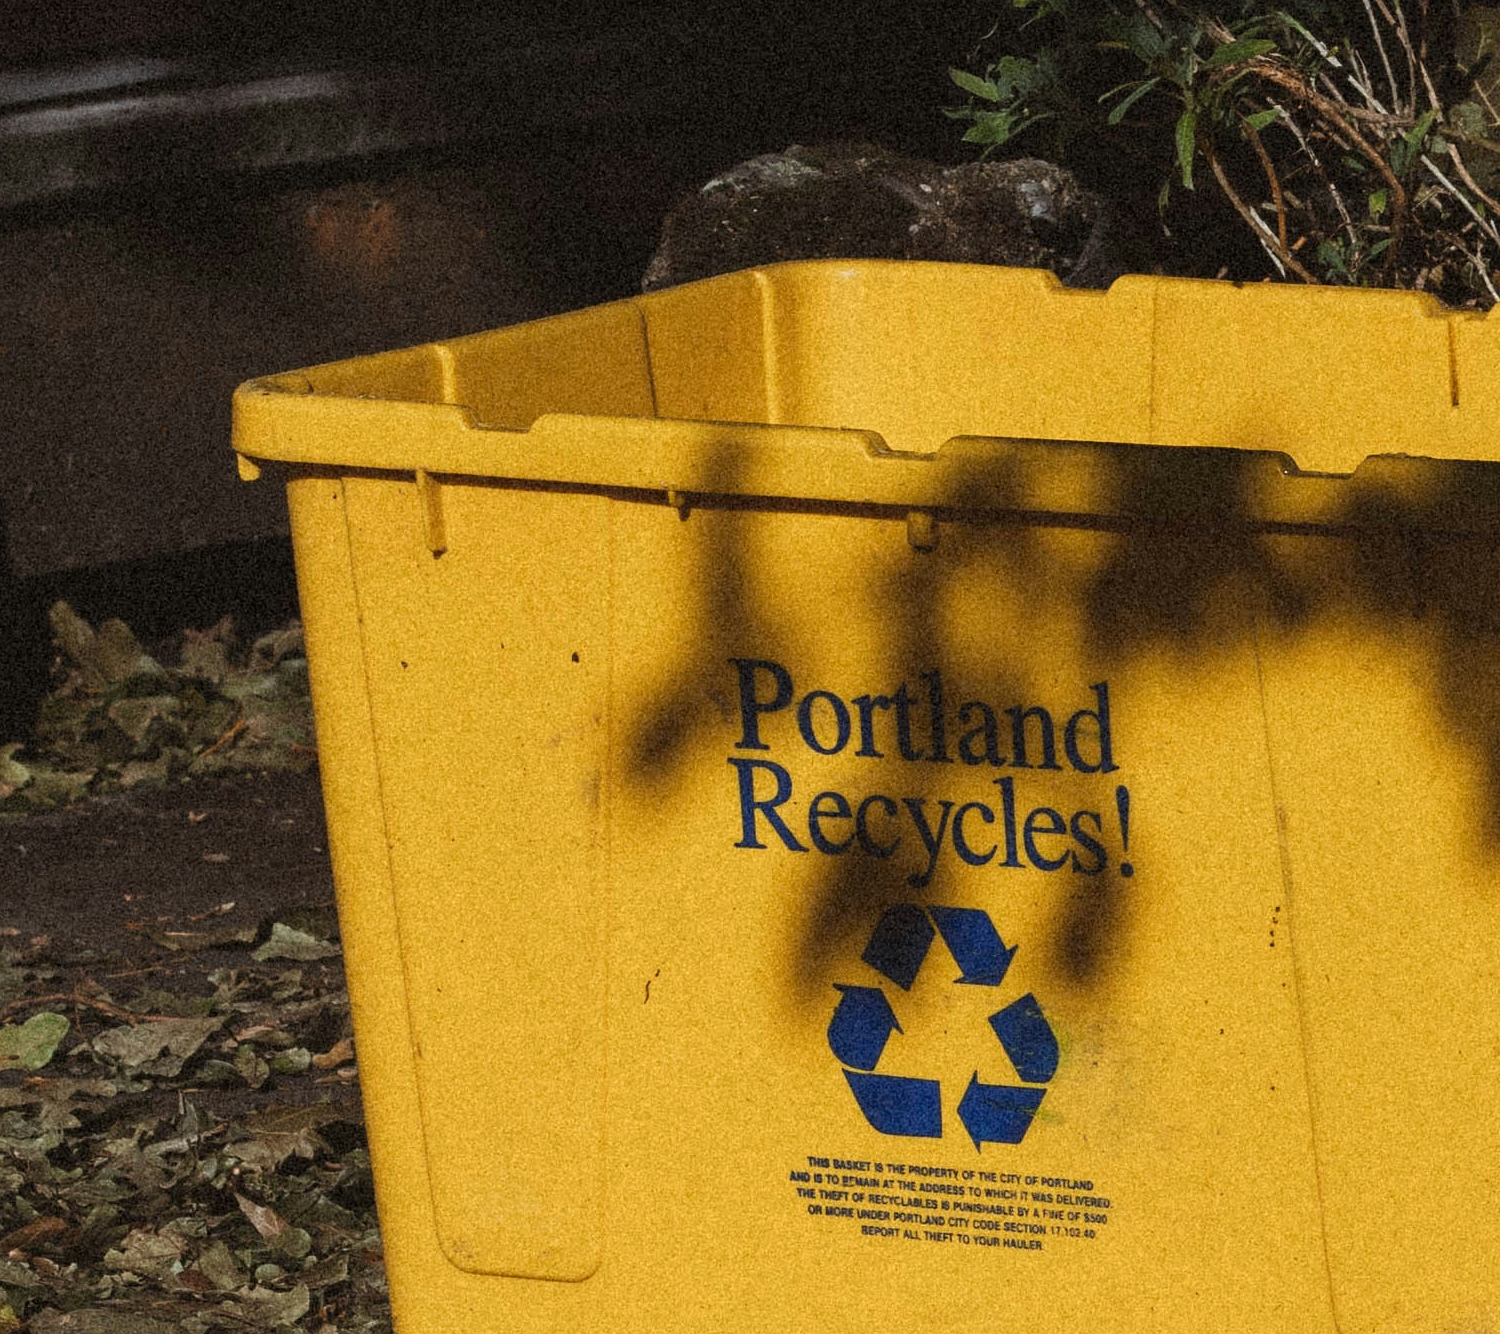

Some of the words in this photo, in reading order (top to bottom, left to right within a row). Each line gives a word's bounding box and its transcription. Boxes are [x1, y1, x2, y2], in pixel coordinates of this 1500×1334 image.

[727, 657, 1120, 775] Portland
[727, 757, 1134, 887] Recycles!
[789, 1171, 810, 1182] AND
[813, 1173, 823, 1183] IS
[825, 1174, 839, 1184] TO
[883, 1179, 894, 1189] AT
[897, 1180, 917, 1191] THE
[919, 1182, 965, 1195] ADDRESS
[968, 1186, 981, 1197] TO
[984, 1188, 1017, 1200] WHICH
[1020, 1191, 1028, 1201] IT
[1030, 1192, 1053, 1203] WAS
[806, 1156, 830, 1168] THIS
[832, 1158, 871, 1171] BASKET
[874, 1162, 884, 1172] IS
[887, 1163, 905, 1174] THE
[908, 1165, 959, 1179] PROPERTY
[961, 1170, 976, 1180] OF
[979, 1171, 997, 1182] THE
[1000, 1173, 1022, 1184] CITY
[1024, 1175, 1039, 1185] OF
[1040, 1177, 1094, 1190] PORTLAND
[796, 1187, 816, 1198] THE
[818, 1189, 849, 1201] THEFT
[852, 1192, 866, 1203] OF
[868, 1194, 938, 1209] RECYCLABLES
[941, 1200, 950, 1210] IS
[953, 1201, 1014, 1216] PUNISHABLE
[1017, 1206, 1029, 1217] BY
[1067, 1211, 1081, 1221] OF
[807, 1204, 822, 1215] OR
[825, 1206, 854, 1217] MORE
[856, 1208, 890, 1221] UNDER
[893, 1212, 946, 1225] PORTLAND
[948, 1216, 970, 1227] CITY
[972, 1219, 1001, 1230] CODE
[1003, 1221, 1047, 1234] SECTION
[903, 1229, 921, 1239] ALL
[923, 1231, 954, 1242] THEFT
[956, 1234, 970, 1244] TO
[972, 1235, 1000, 1246] YOUR
[1003, 1238, 1043, 1250] HAULER
